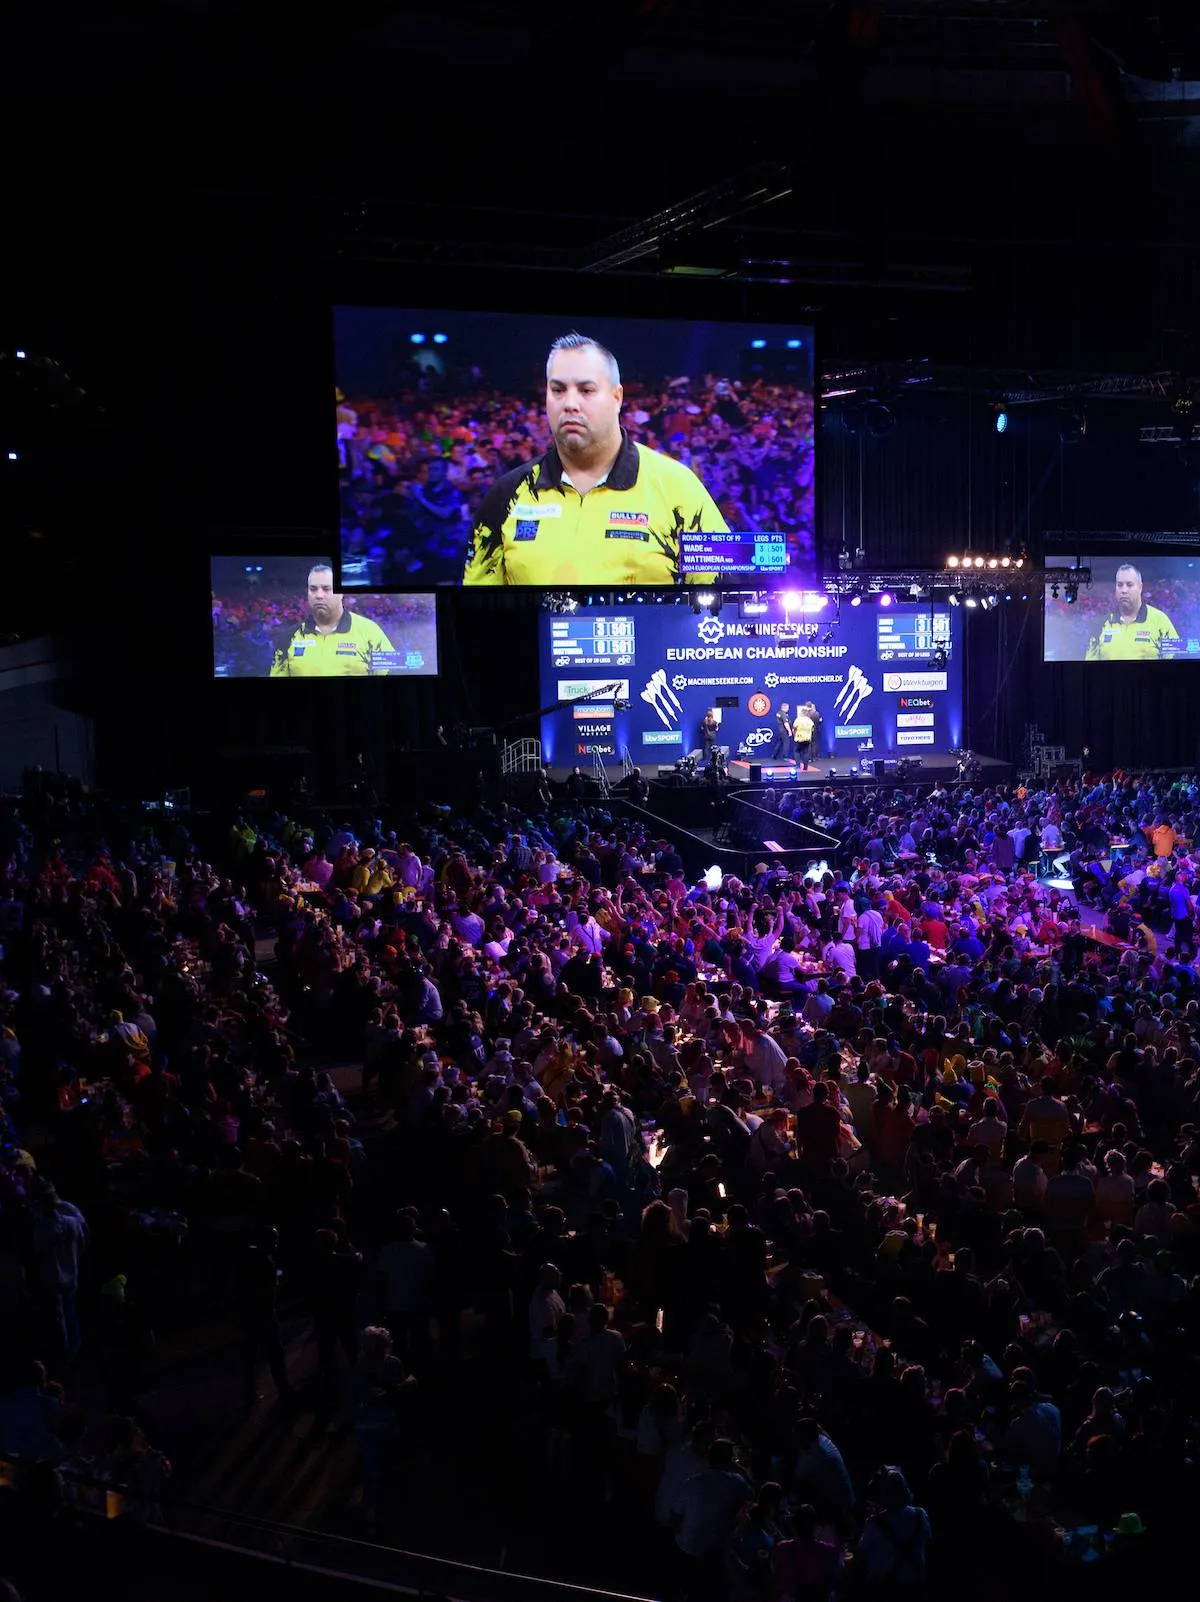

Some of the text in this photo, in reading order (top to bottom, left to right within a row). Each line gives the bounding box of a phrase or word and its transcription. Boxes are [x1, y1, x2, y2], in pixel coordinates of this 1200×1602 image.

[684, 544, 704, 552] WADE
[684, 555, 724, 563] WATTIMENA
[612, 622, 632, 636] 501
[612, 640, 632, 654] 501
[666, 646, 848, 660] EUROPEAN CHAMPIONSHIP
[688, 677, 754, 686] MACHINESEEKER.COM
[780, 675, 843, 684] MASCHINENSUCHER.DE
[748, 731, 772, 744] PDC
